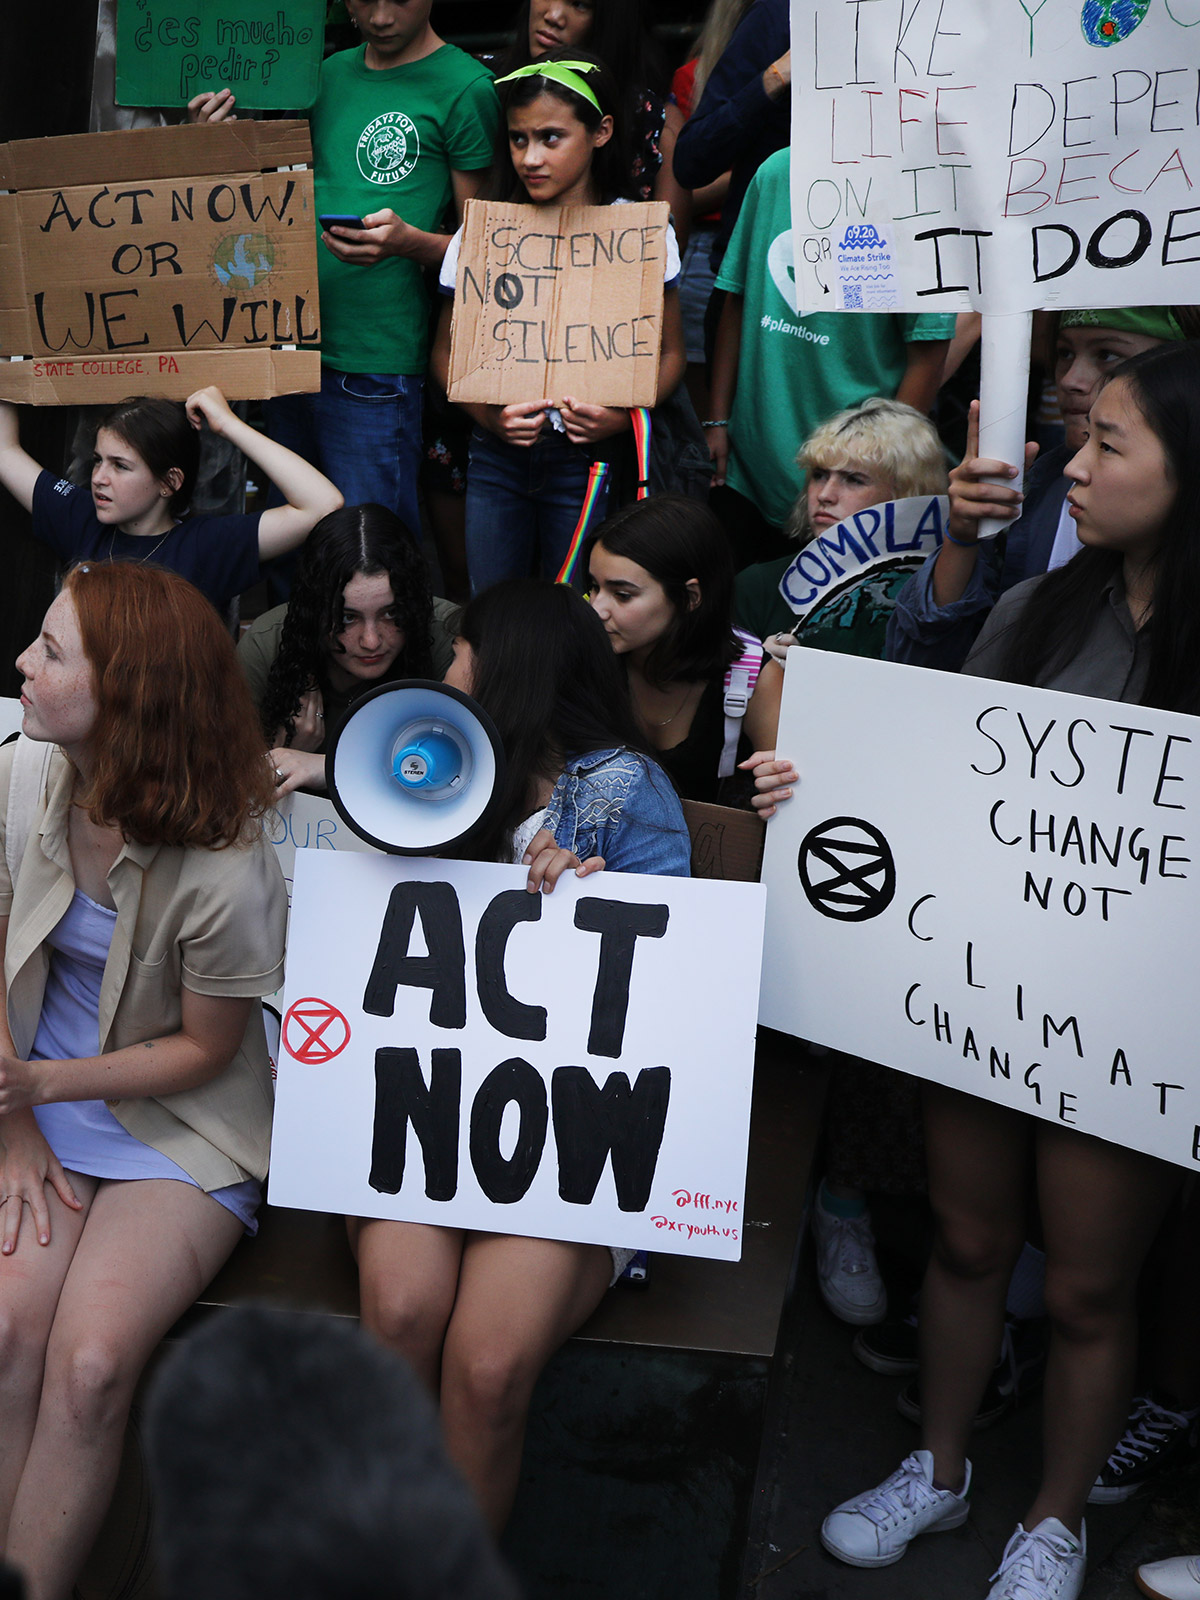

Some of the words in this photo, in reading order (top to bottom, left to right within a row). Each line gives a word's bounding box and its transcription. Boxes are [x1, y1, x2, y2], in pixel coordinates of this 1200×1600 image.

[217, 11, 312, 46] mucho
[815, 0, 961, 90] LIKE
[180, 47, 280, 99] pedir?
[359, 114, 394, 148] FRIDAYS
[395, 115, 413, 134] FOR
[832, 85, 976, 164] LIFE
[1007, 68, 1200, 157] DEPE
[371, 161, 413, 183] FUTURE
[807, 177, 872, 230] ON
[893, 164, 972, 220] IT
[1001, 148, 1193, 218] BECA
[40, 186, 154, 233] ACT
[847, 226, 875, 239] 09.20
[111, 241, 183, 278] OR
[491, 225, 663, 270] SCIENCE
[803, 237, 832, 264] QR
[837, 253, 865, 263] Climate
[867, 252, 891, 262] Strike
[913, 228, 993, 296] IT
[463, 266, 557, 310] NOT
[34, 289, 150, 352] WE
[172, 294, 319, 347] WILL
[493, 314, 656, 363] SILENCE
[760, 314, 830, 346] #plantlove
[33, 362, 74, 377] STATE
[158, 356, 180, 374] PA
[970, 705, 1192, 810] SYSTE
[990, 800, 1192, 885] CHANGE
[1023, 871, 1132, 921] NOT
[362, 880, 670, 1059] ACT
[905, 982, 1077, 1125] CHANGE
[368, 1046, 672, 1213] NOW
[671, 1189, 738, 1214] @fff.nyc
